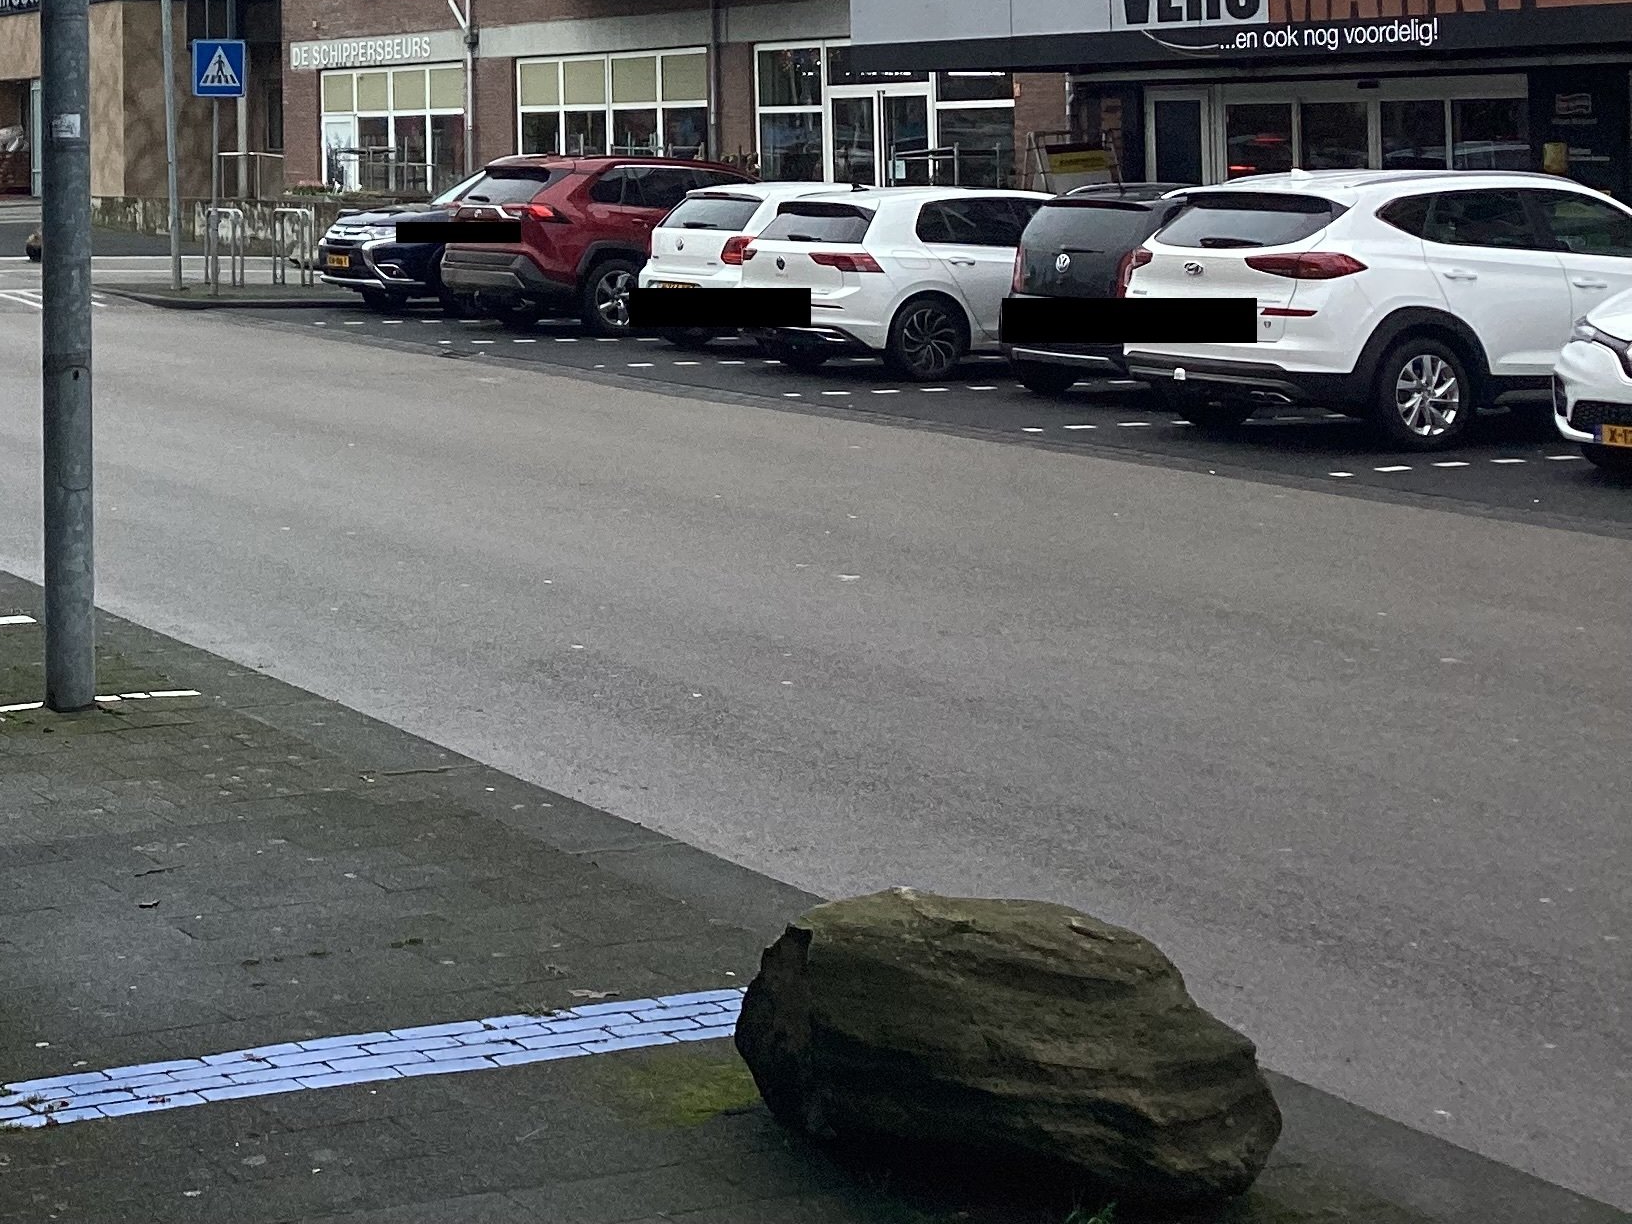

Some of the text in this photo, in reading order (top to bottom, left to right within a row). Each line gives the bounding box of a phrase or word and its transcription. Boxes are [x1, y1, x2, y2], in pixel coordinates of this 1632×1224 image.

[1263, 26, 1299, 48] ook
[1304, 28, 1339, 51] nog
[1344, 17, 1439, 47] voordelig!
[292, 36, 431, 67] DE SCHIPPERSBEURS
